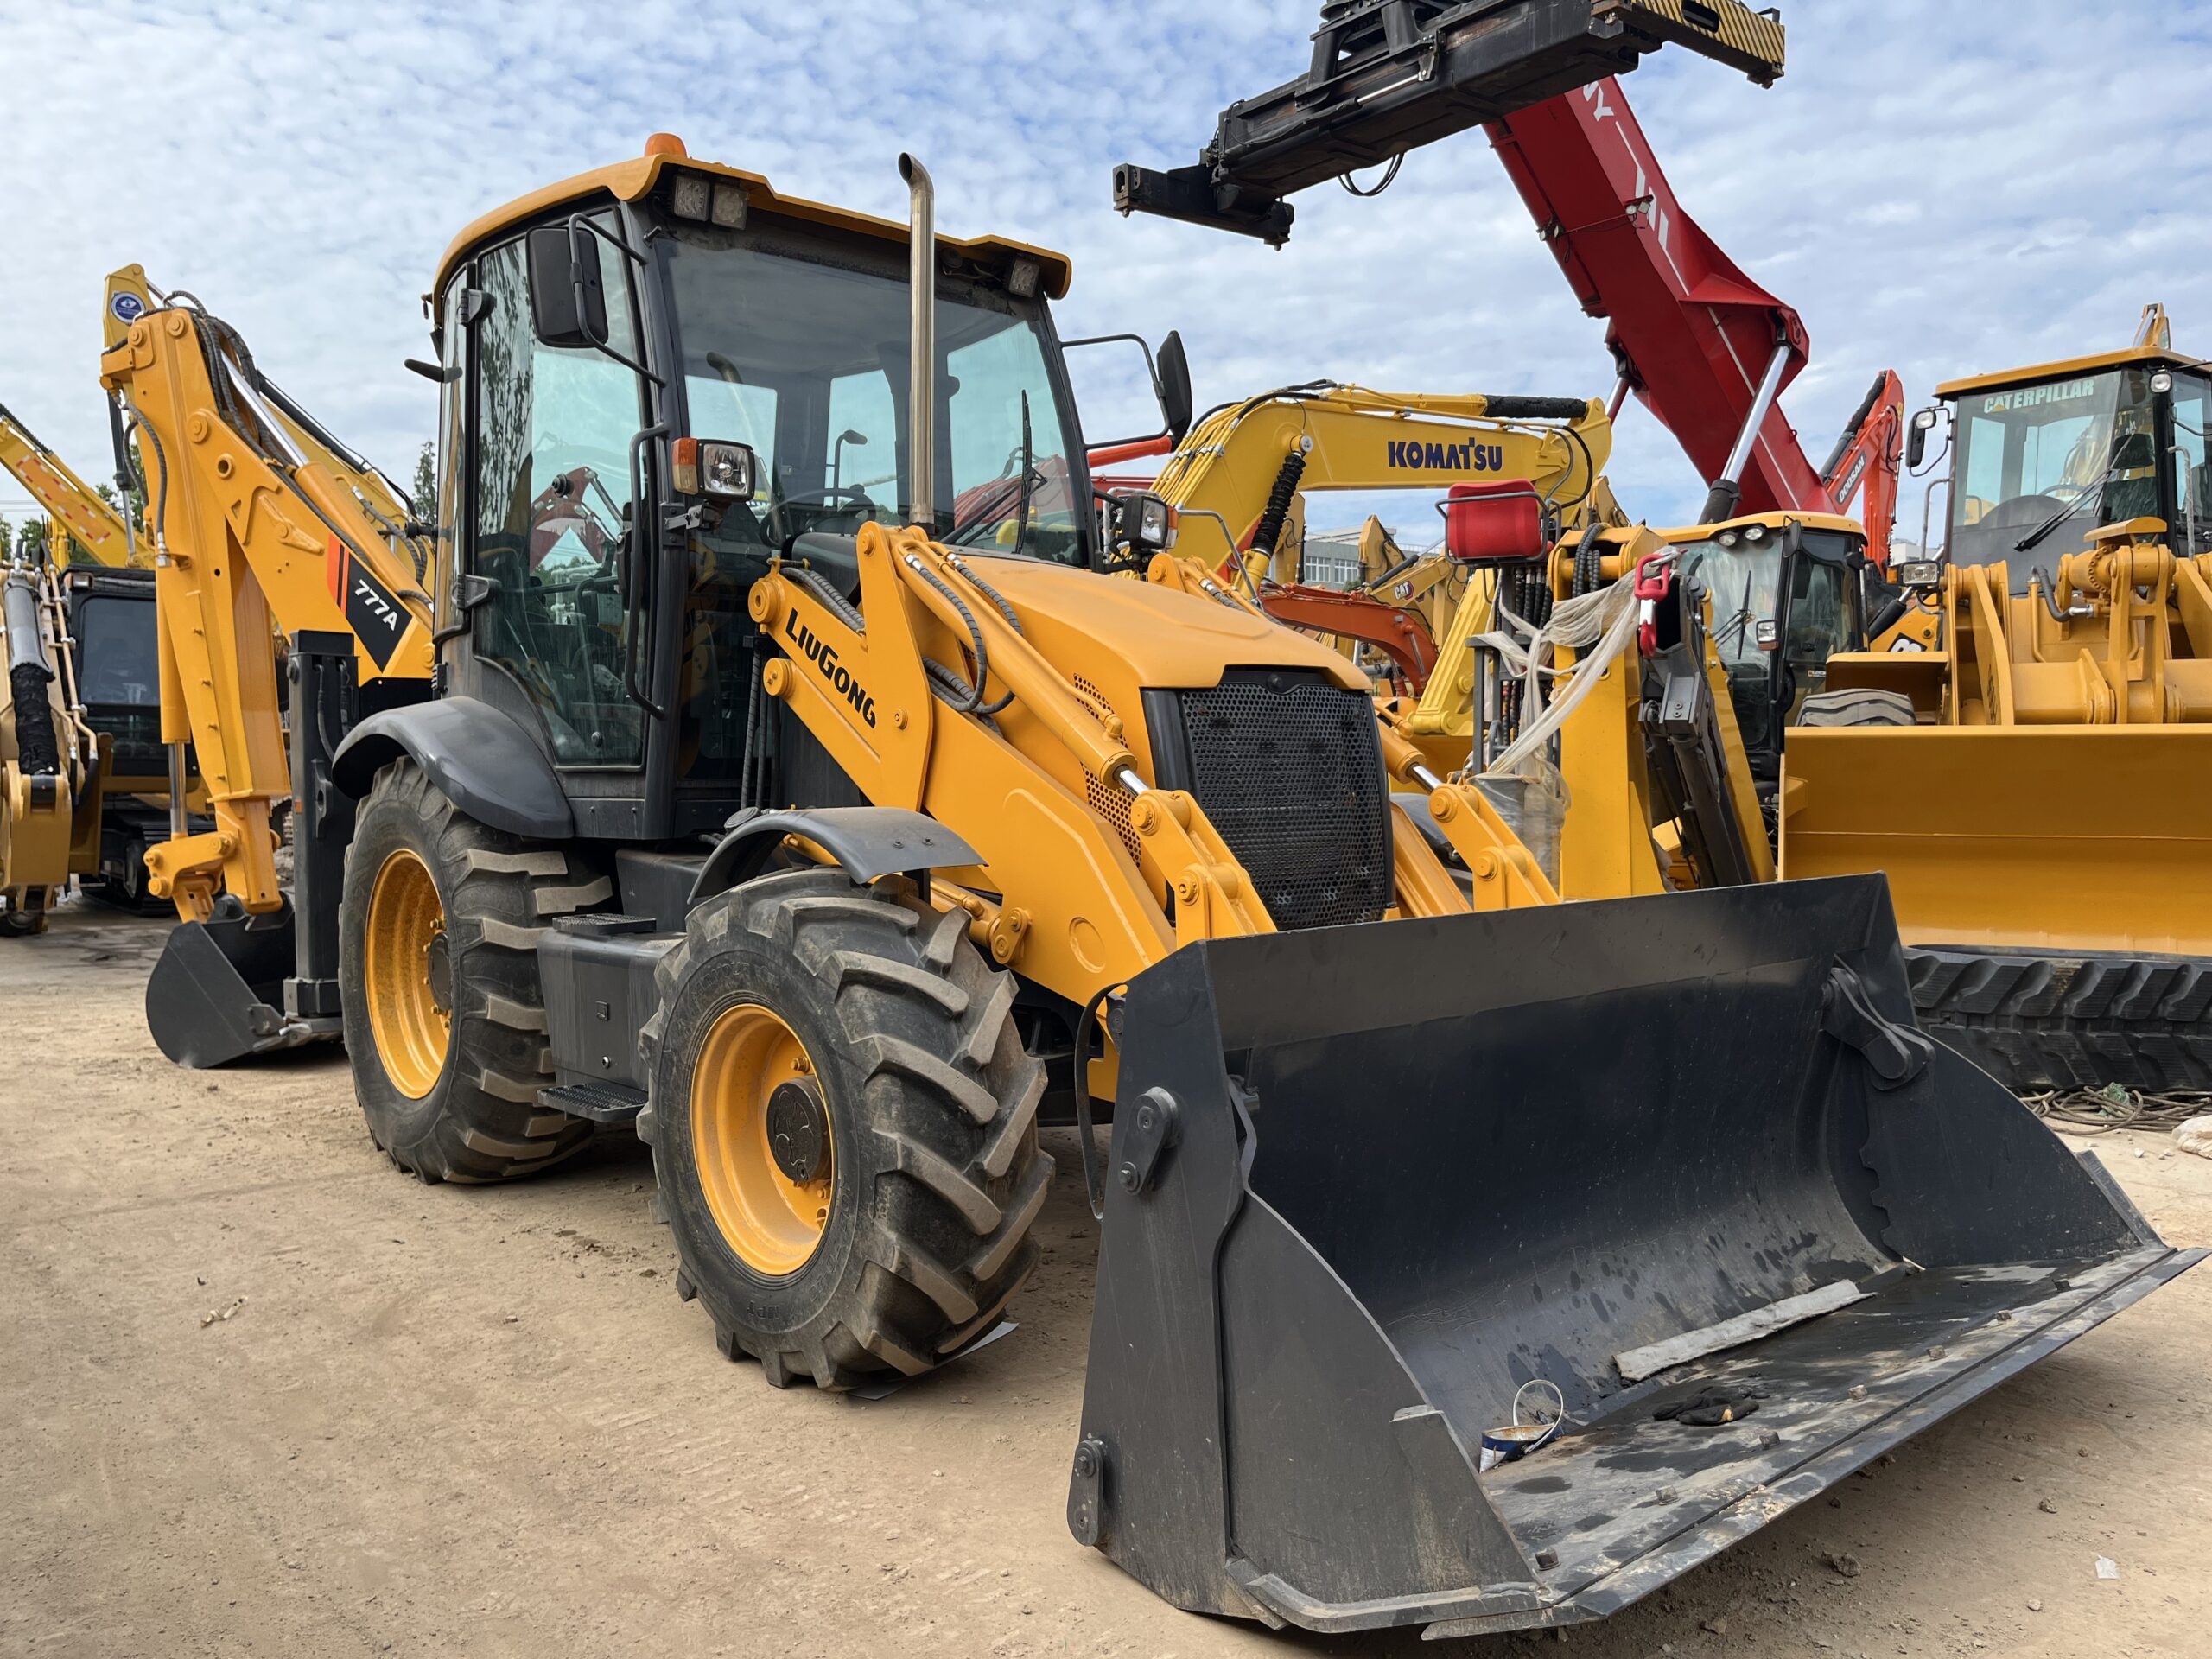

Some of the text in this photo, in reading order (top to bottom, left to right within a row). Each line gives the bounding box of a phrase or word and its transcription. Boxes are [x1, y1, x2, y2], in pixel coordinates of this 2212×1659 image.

[1984, 379, 2094, 414] CATERPILLAR
[1388, 437, 1502, 471] KOMATSU
[1839, 455, 1865, 503] DOOSAN
[354, 579, 397, 632] 777A
[1394, 581, 1409, 600] CAT
